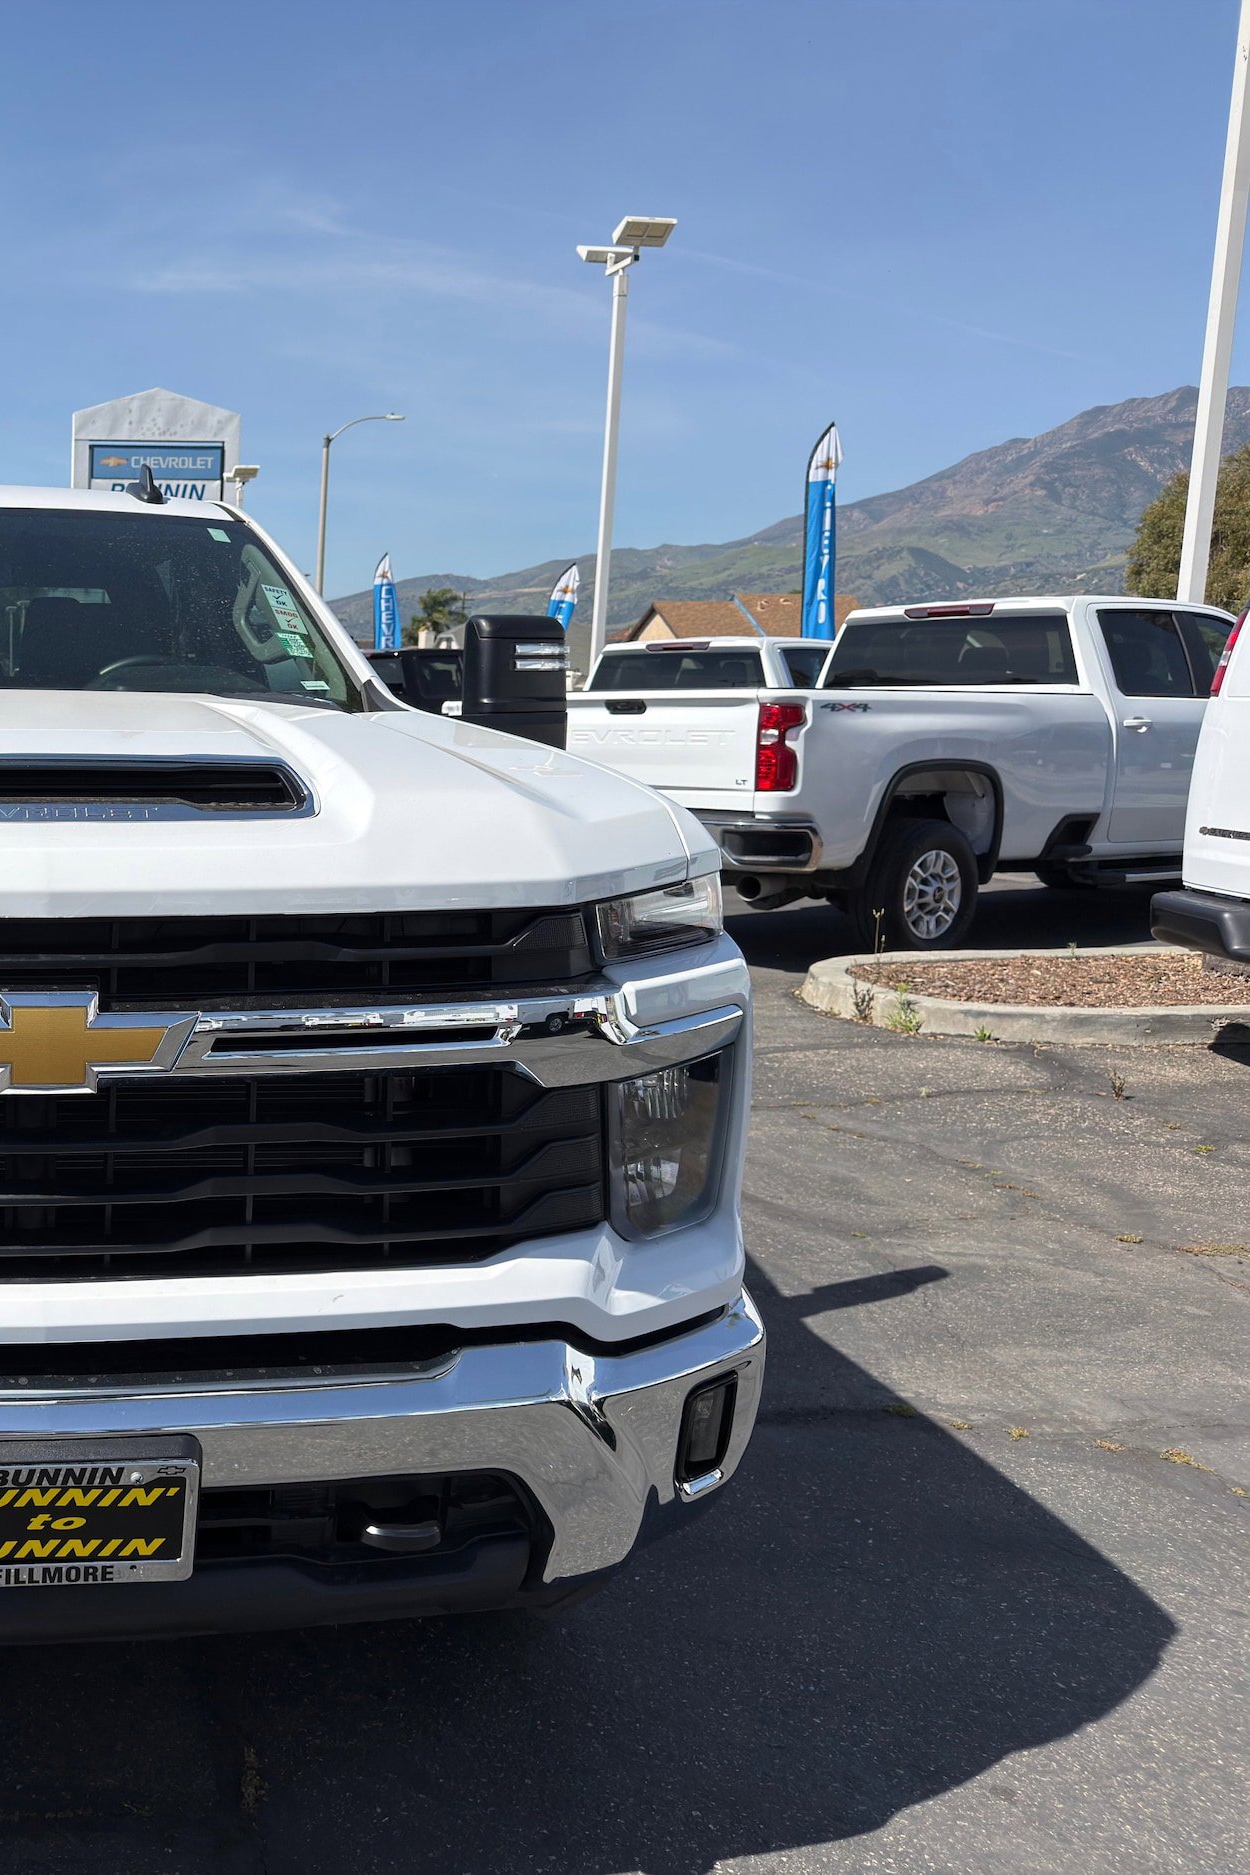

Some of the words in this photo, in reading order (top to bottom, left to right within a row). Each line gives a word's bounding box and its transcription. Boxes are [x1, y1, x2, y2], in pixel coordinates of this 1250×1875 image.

[131, 456, 214, 469] CHEVROLET
[264, 586, 288, 595] SAFETY
[26, 1513, 87, 1530] to
